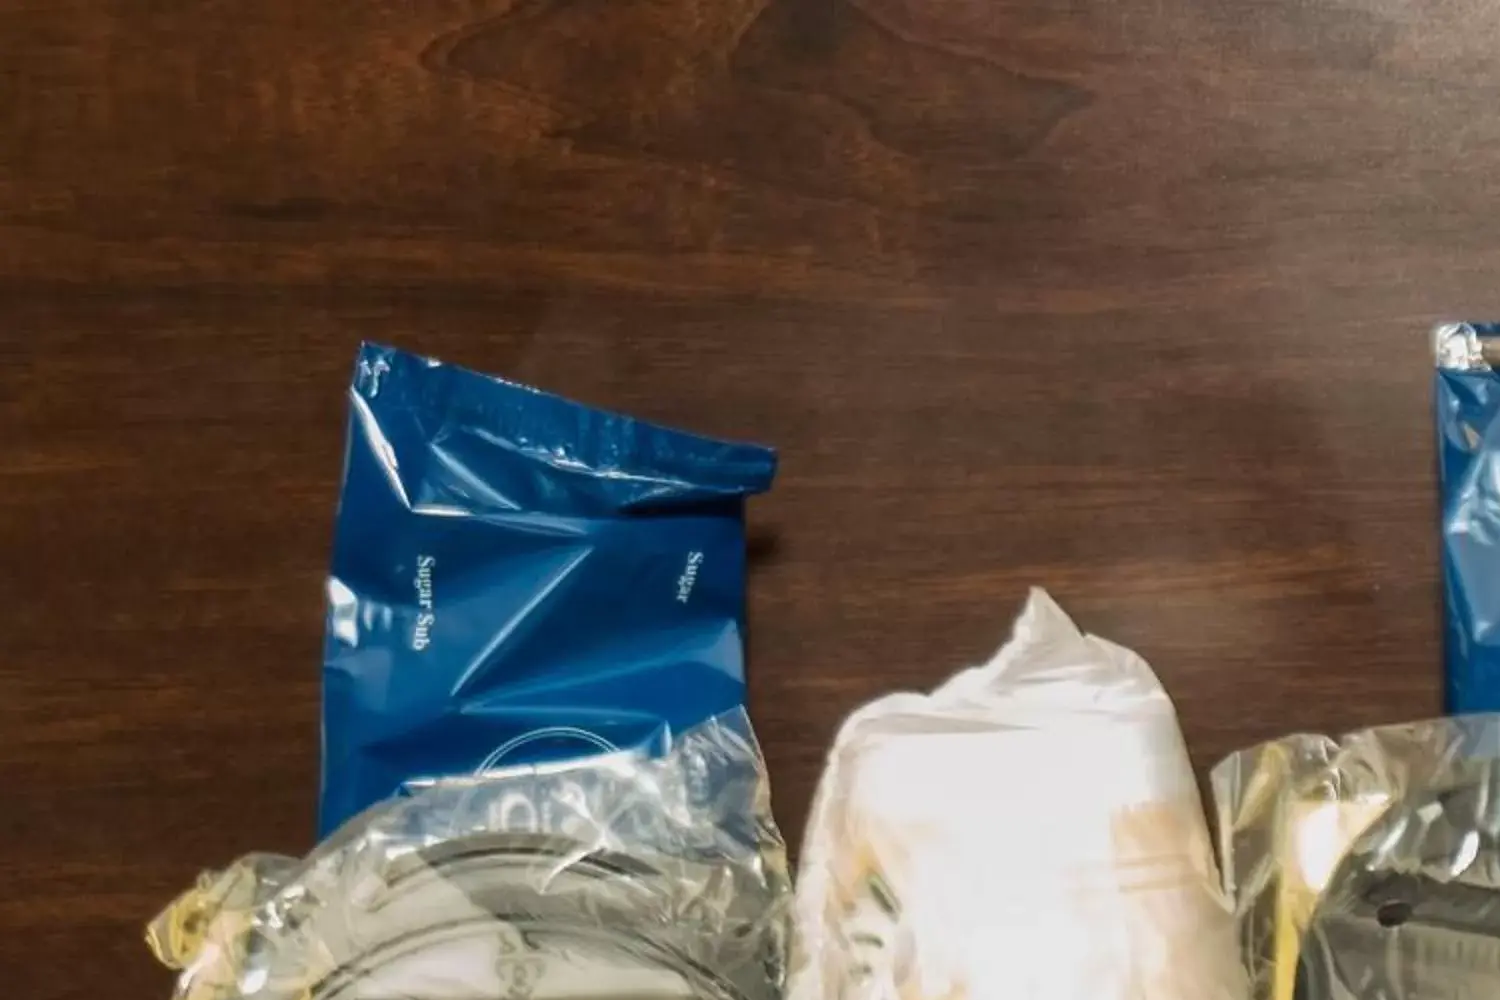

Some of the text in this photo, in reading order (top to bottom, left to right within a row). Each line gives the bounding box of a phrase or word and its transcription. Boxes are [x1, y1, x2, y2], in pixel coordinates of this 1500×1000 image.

[413, 555, 436, 651] Sugar Sub
[676, 550, 705, 604] Sugar
